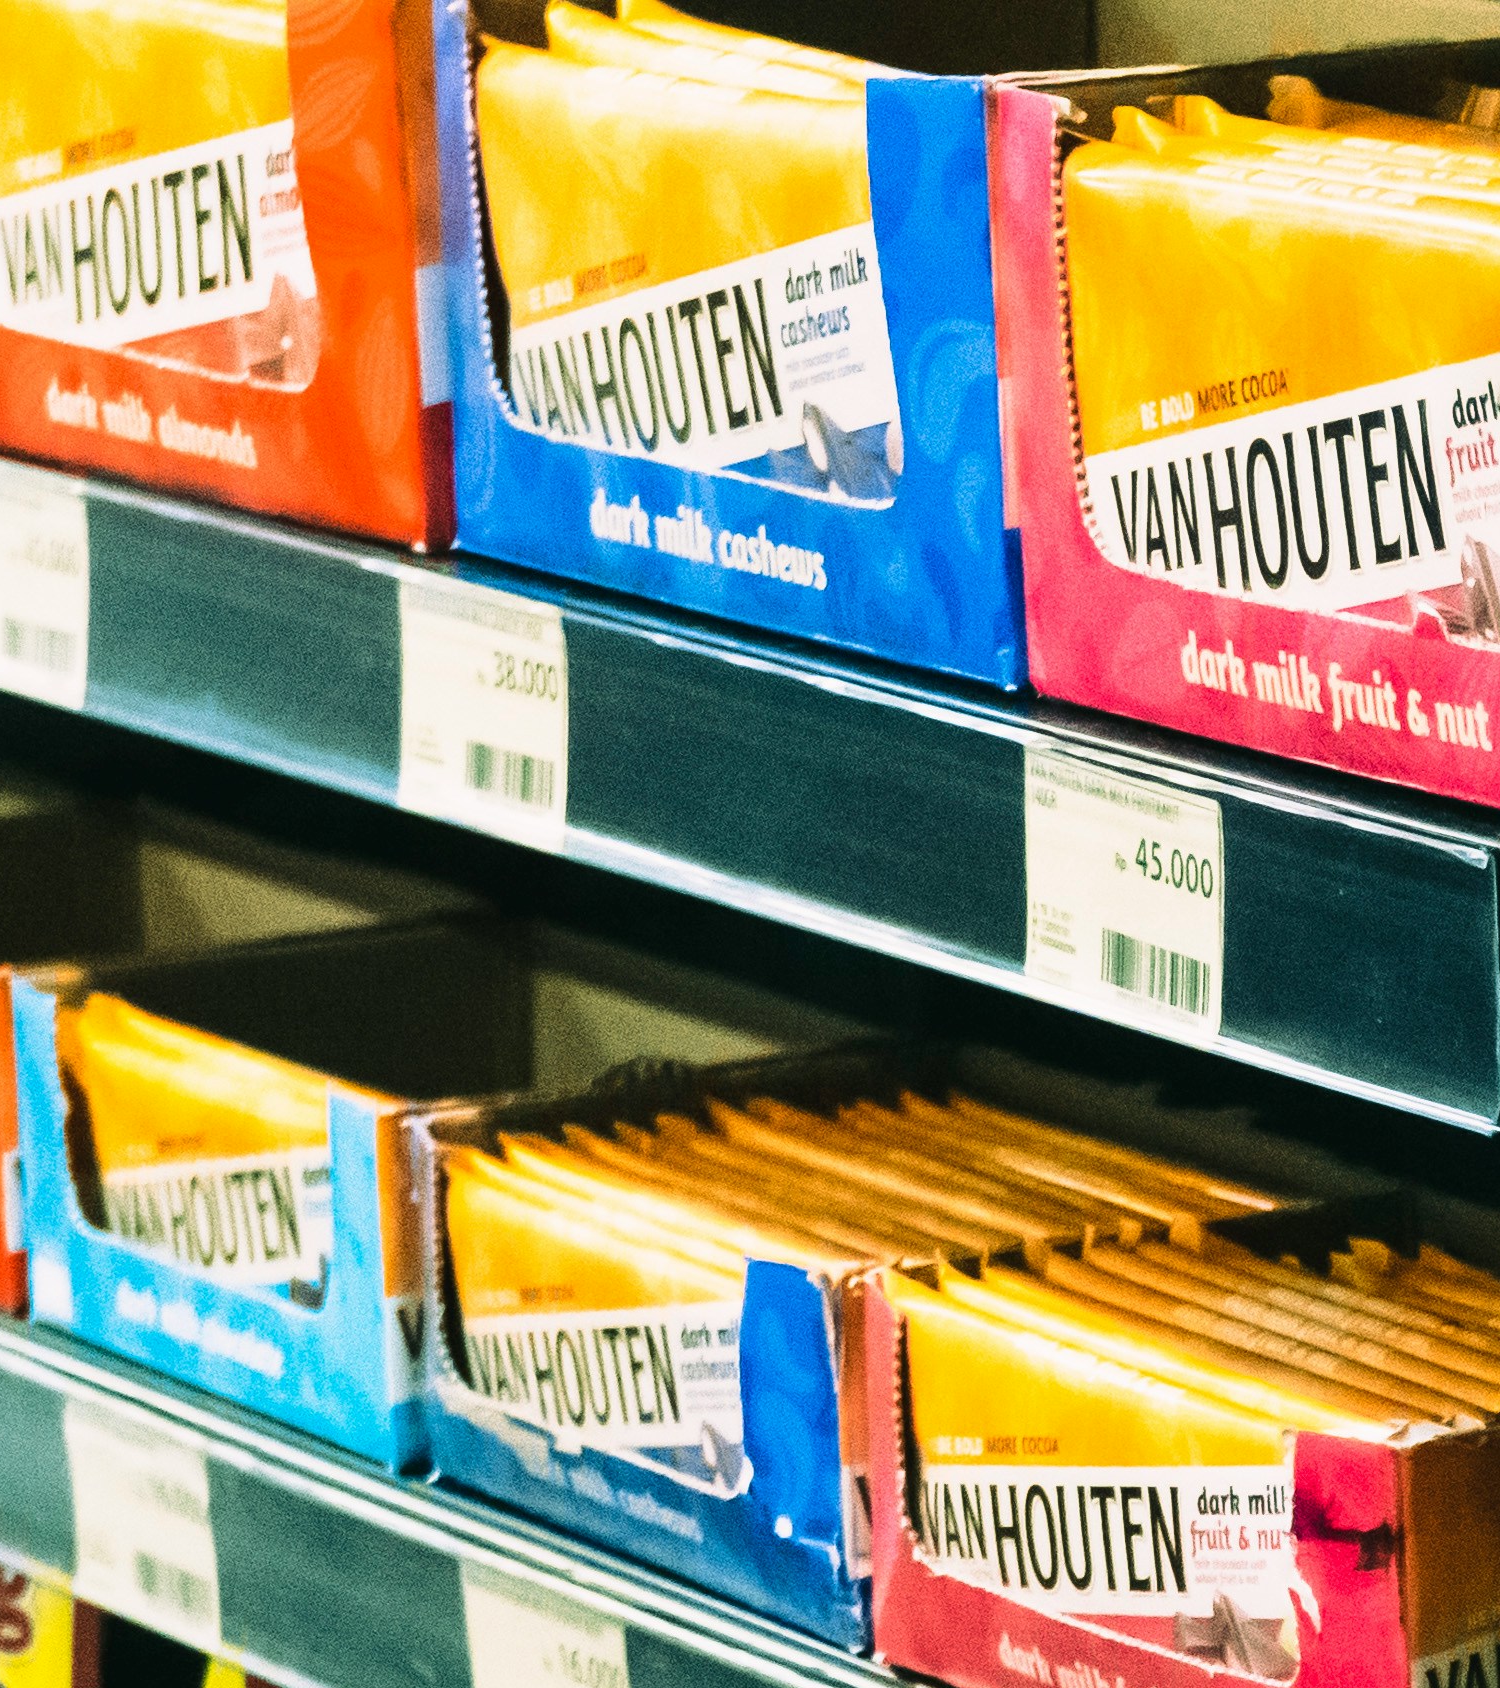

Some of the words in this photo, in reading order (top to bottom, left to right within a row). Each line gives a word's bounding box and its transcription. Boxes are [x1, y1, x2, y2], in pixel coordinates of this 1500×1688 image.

[0, 203, 66, 305] VAN
[69, 154, 254, 324] HOUTEN
[785, 266, 824, 304] dark
[829, 248, 869, 292] milk
[780, 303, 850, 348] cashews
[513, 336, 591, 437] VAN
[583, 277, 784, 453] HOUTEN
[1140, 403, 1158, 431] BE
[1160, 395, 1195, 426] BOLD
[1197, 378, 1238, 415] MORE
[1241, 368, 1290, 405] COCOA
[158, 404, 258, 470] almonds
[1444, 428, 1499, 488] fruit
[1110, 456, 1204, 571] VAN
[1201, 397, 1449, 592] HOUTEN
[589, 487, 651, 548] dark
[655, 503, 714, 563] milk
[717, 523, 828, 591] cashews
[1181, 630, 1248, 695] dark
[1253, 652, 1323, 713] milk
[1327, 666, 1399, 732] fruit
[1406, 691, 1431, 737] &
[1435, 702, 1494, 752] nut
[1135, 838, 1213, 898] 45.000
[169, 1163, 303, 1268] HOUTEN
[468, 1329, 532, 1401] VAN
[529, 1323, 682, 1427] HOUTEN
[986, 1436, 1018, 1455] MORE
[1022, 1436, 1060, 1455] COCOA
[1197, 1485, 1241, 1516] dark
[924, 1482, 987, 1560] VAN
[989, 1484, 1189, 1593] HOUTEN
[1190, 1520, 1234, 1557] fruit
[1238, 1522, 1249, 1550] &
[998, 1633, 1053, 1686] dark
